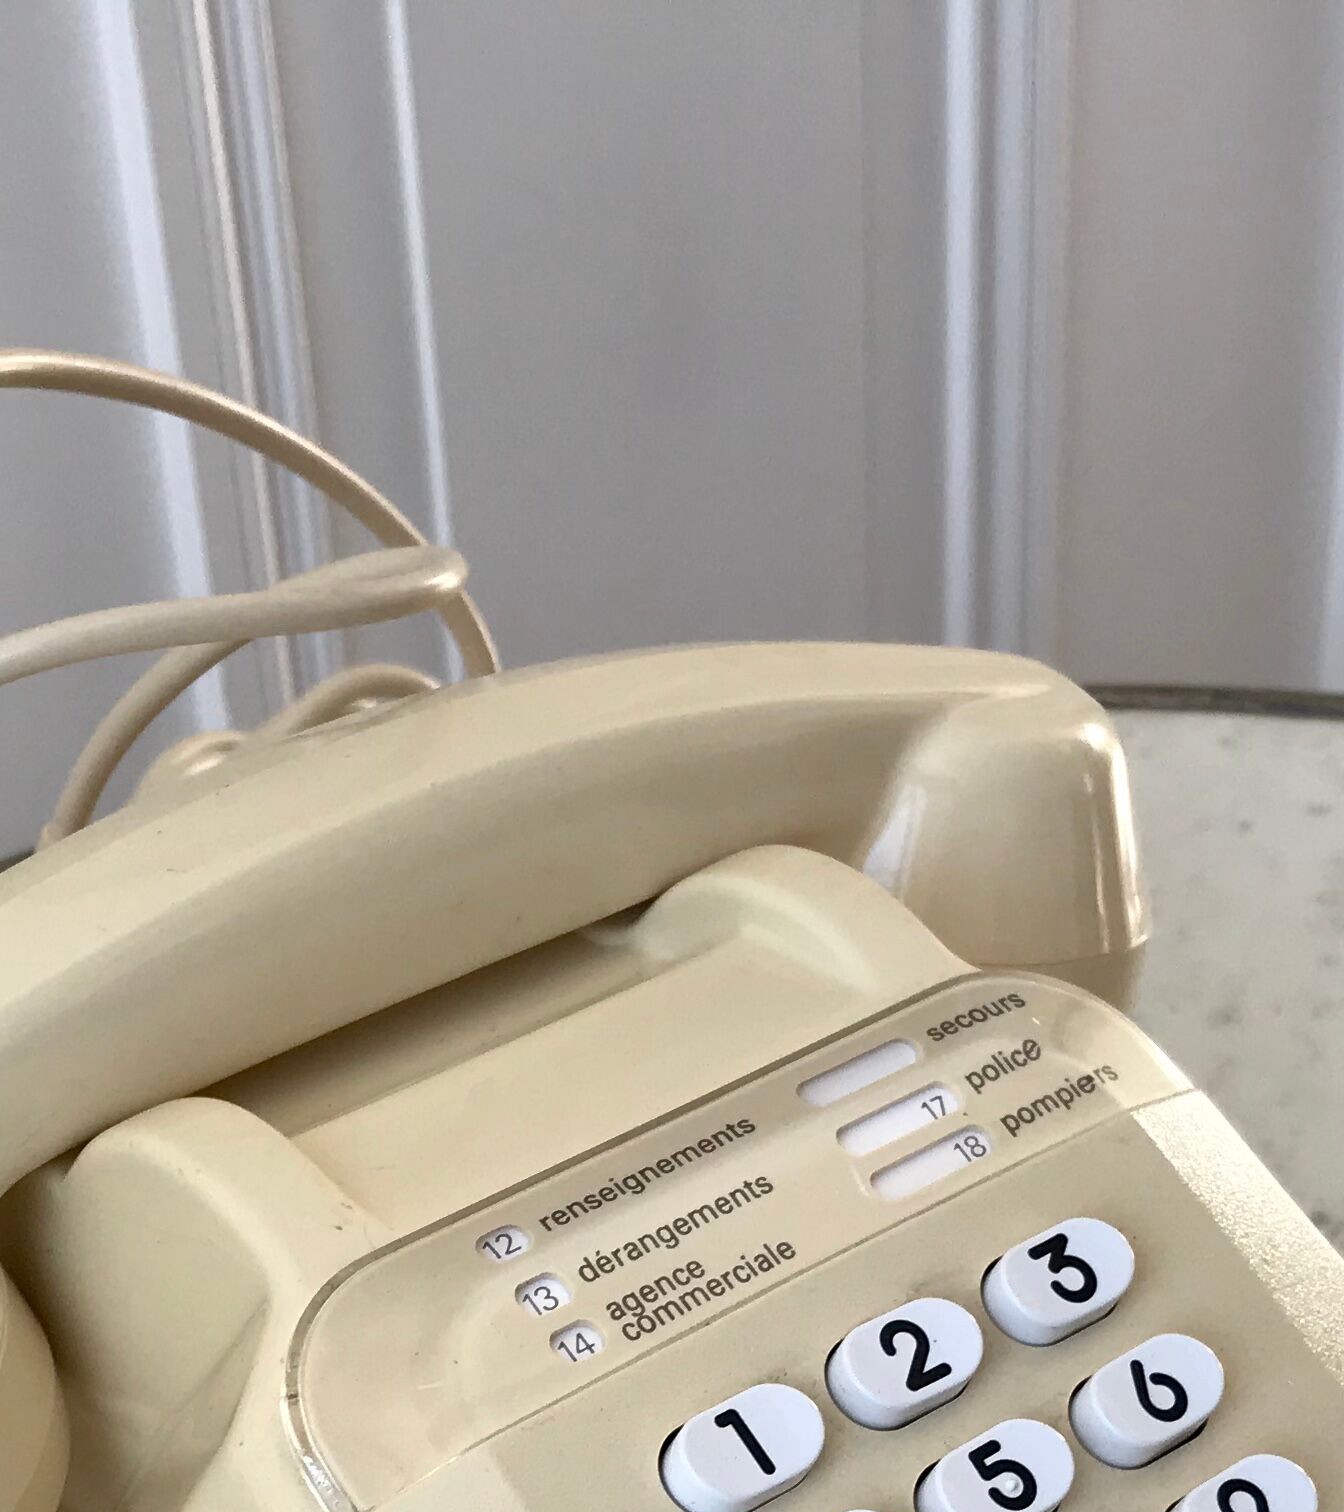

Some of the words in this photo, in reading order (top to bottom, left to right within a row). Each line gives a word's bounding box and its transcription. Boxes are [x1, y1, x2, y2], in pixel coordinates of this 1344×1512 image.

[925, 990, 1027, 1043] secours
[920, 1094, 950, 1121] 17
[964, 1036, 1042, 1093] police
[952, 1134, 988, 1163] 18
[999, 1061, 1120, 1137] pompiers
[481, 1231, 522, 1259] 12
[538, 1115, 757, 1233] renseignements
[521, 1284, 561, 1317] 13
[577, 1172, 774, 1284] dérangements
[621, 1237, 796, 1342] commerciale
[556, 1332, 597, 1363] 14
[605, 1257, 707, 1323] agence
[714, 1408, 776, 1475] 1
[879, 1319, 952, 1392] 2
[1027, 1233, 1098, 1304] 3
[968, 1439, 1038, 1511] 5
[1130, 1359, 1189, 1423] 6
